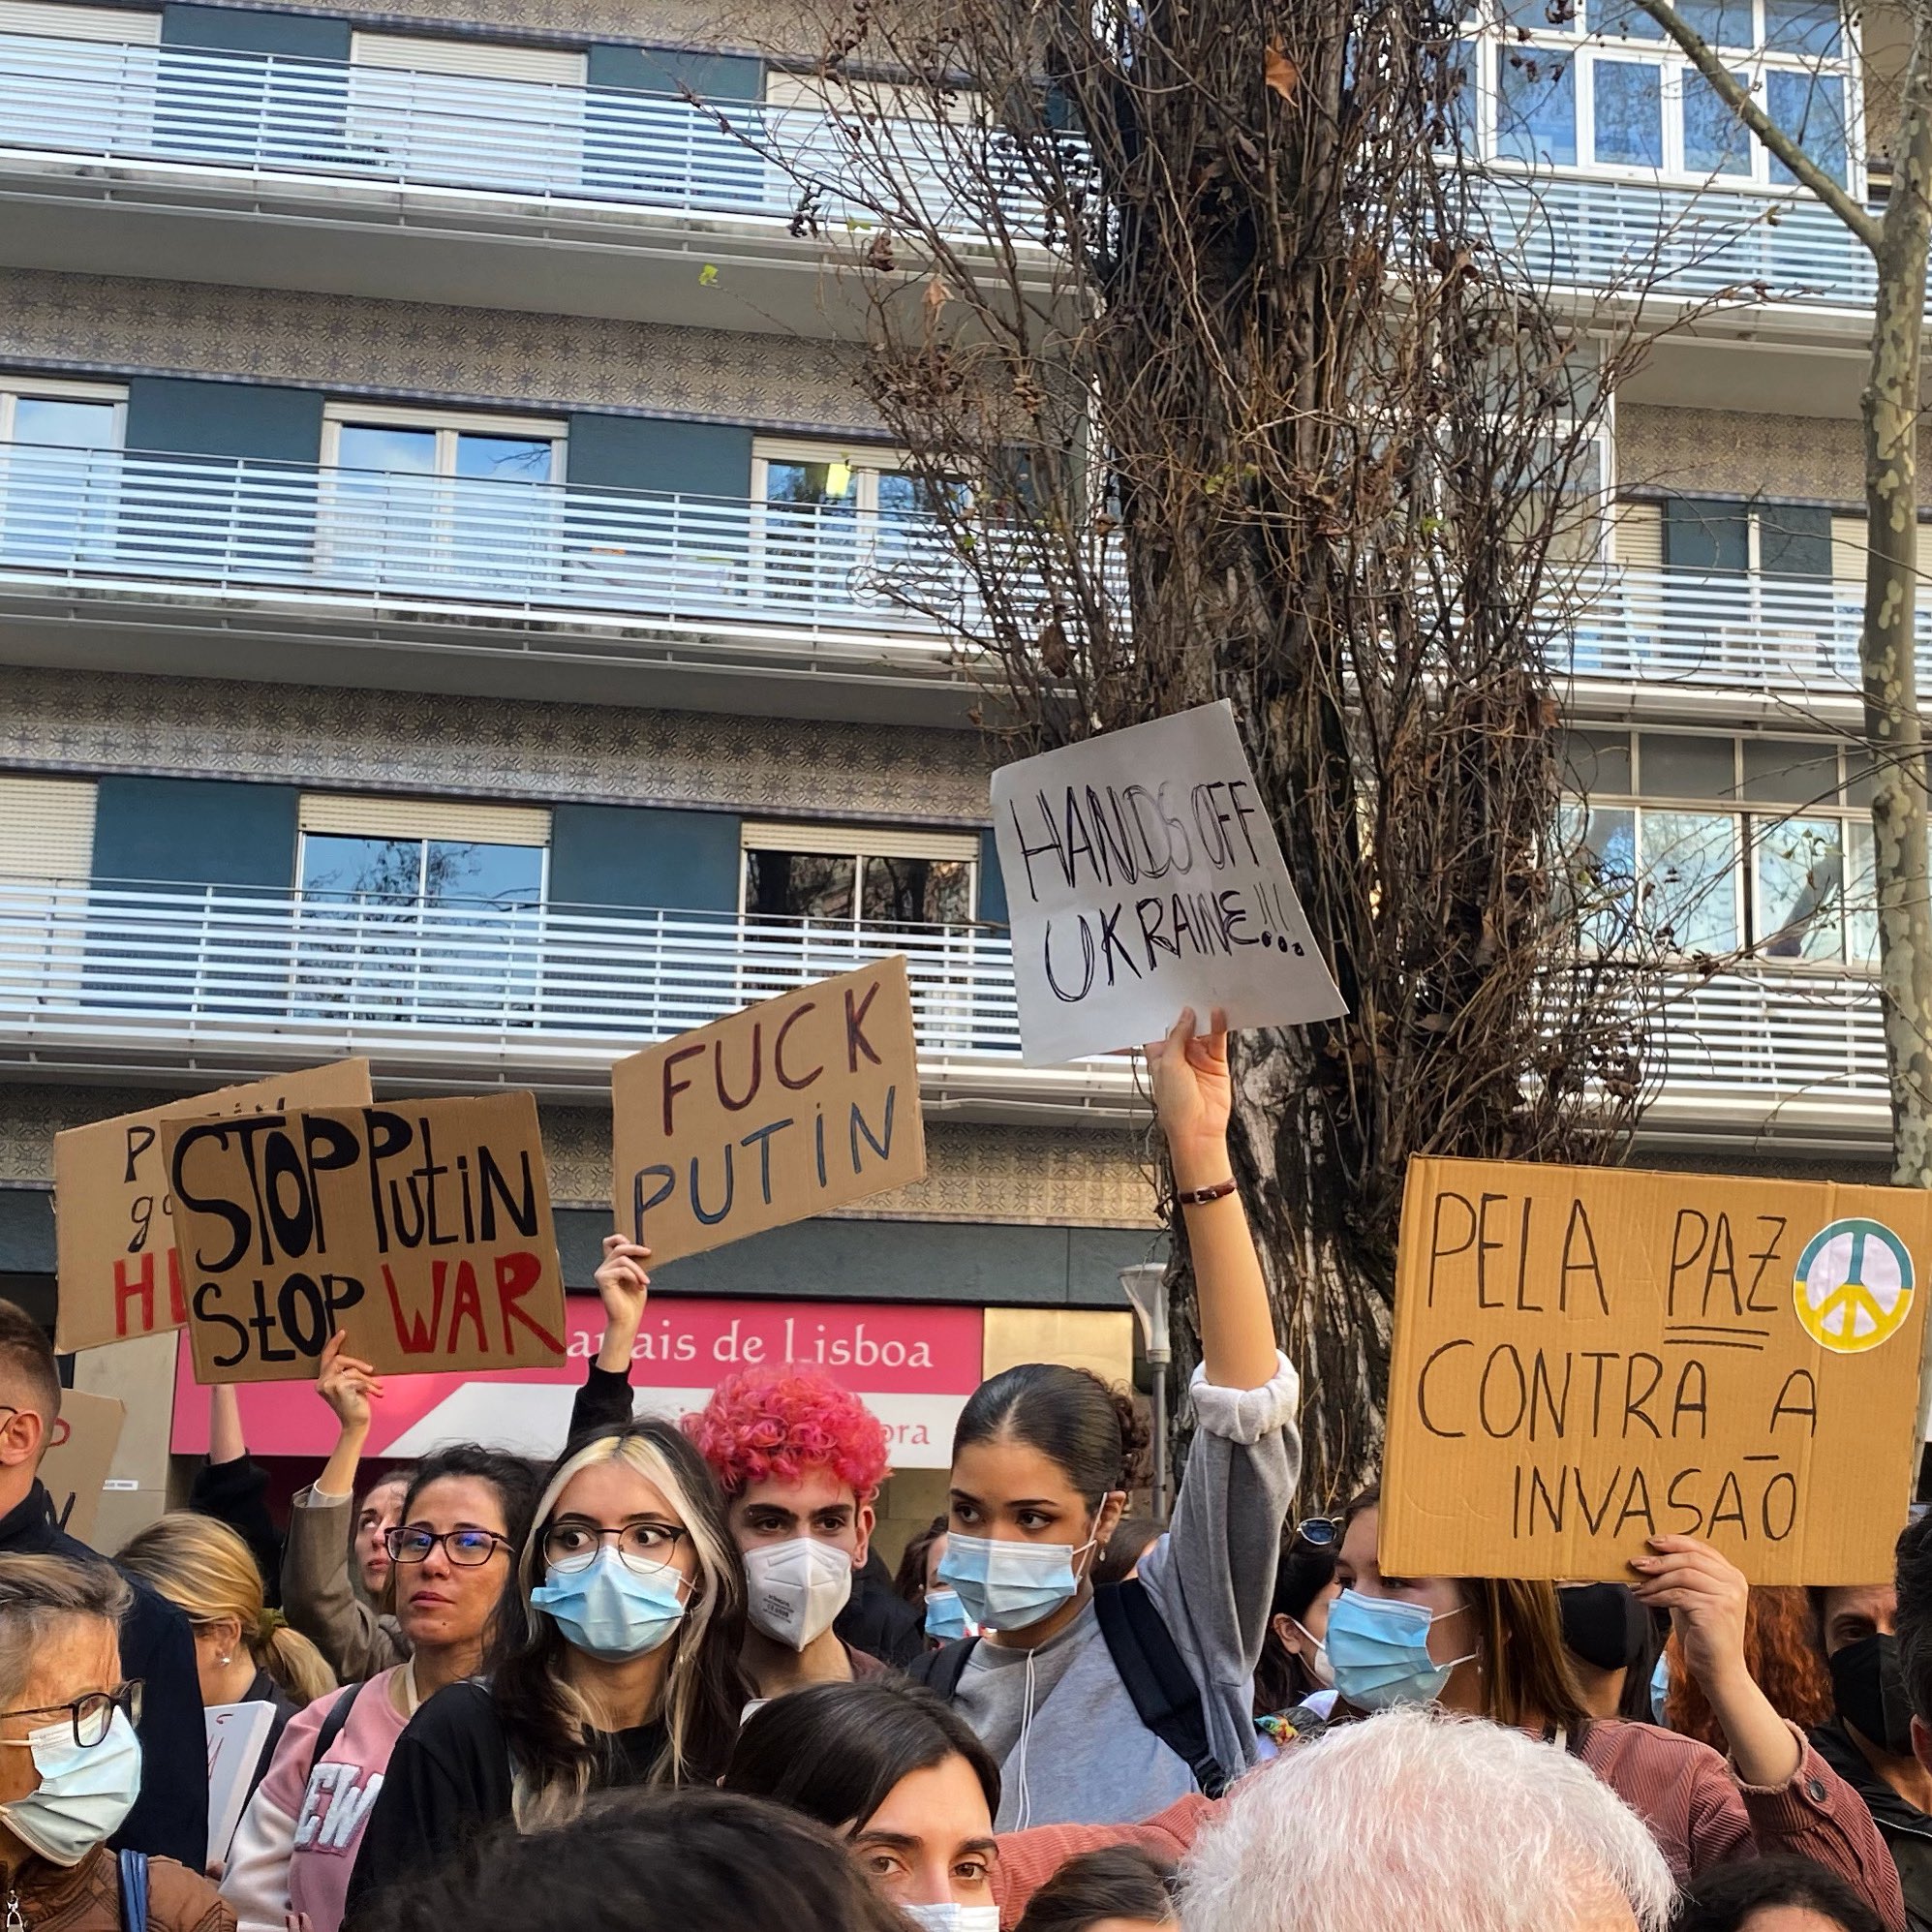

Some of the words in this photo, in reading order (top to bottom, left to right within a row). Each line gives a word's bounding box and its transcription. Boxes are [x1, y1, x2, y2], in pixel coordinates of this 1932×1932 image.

[1009, 780, 1193, 903] HANDS
[1190, 779, 1260, 871] OFF
[662, 980, 882, 1137] FUCK
[171, 1113, 360, 1273] STOP
[381, 1251, 567, 1355] WAR
[1428, 1192, 1610, 1315] PELA
[1667, 1209, 1787, 1317] PAZ
[712, 1318, 766, 1364] de
[784, 1317, 934, 1368] Lisboa
[1418, 1339, 1707, 1441] CONTRA
[1768, 1368, 1819, 1438] A
[1513, 1455, 1798, 1542] INVASÃO
